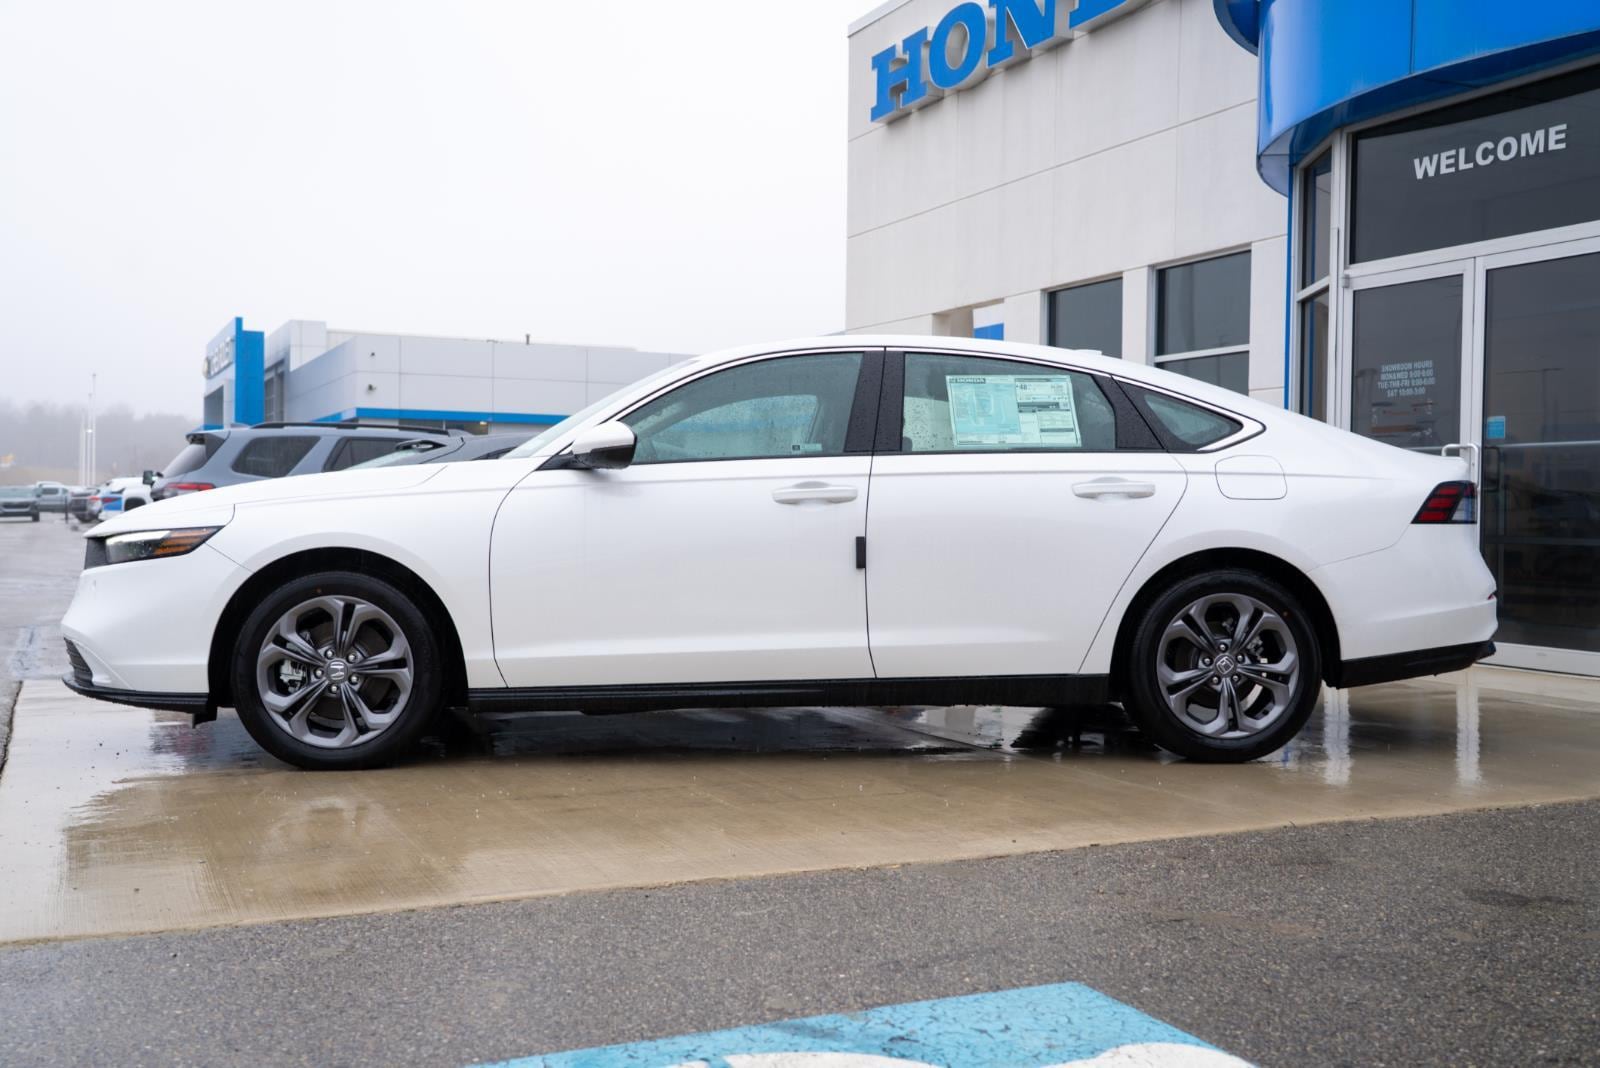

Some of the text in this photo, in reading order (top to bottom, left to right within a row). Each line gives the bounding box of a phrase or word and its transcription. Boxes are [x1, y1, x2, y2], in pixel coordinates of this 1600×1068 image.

[1413, 123, 1567, 180] WELCOME
[1381, 360, 1433, 373] SHOWROOM HOURS
[1387, 389, 1397, 397] SAT
